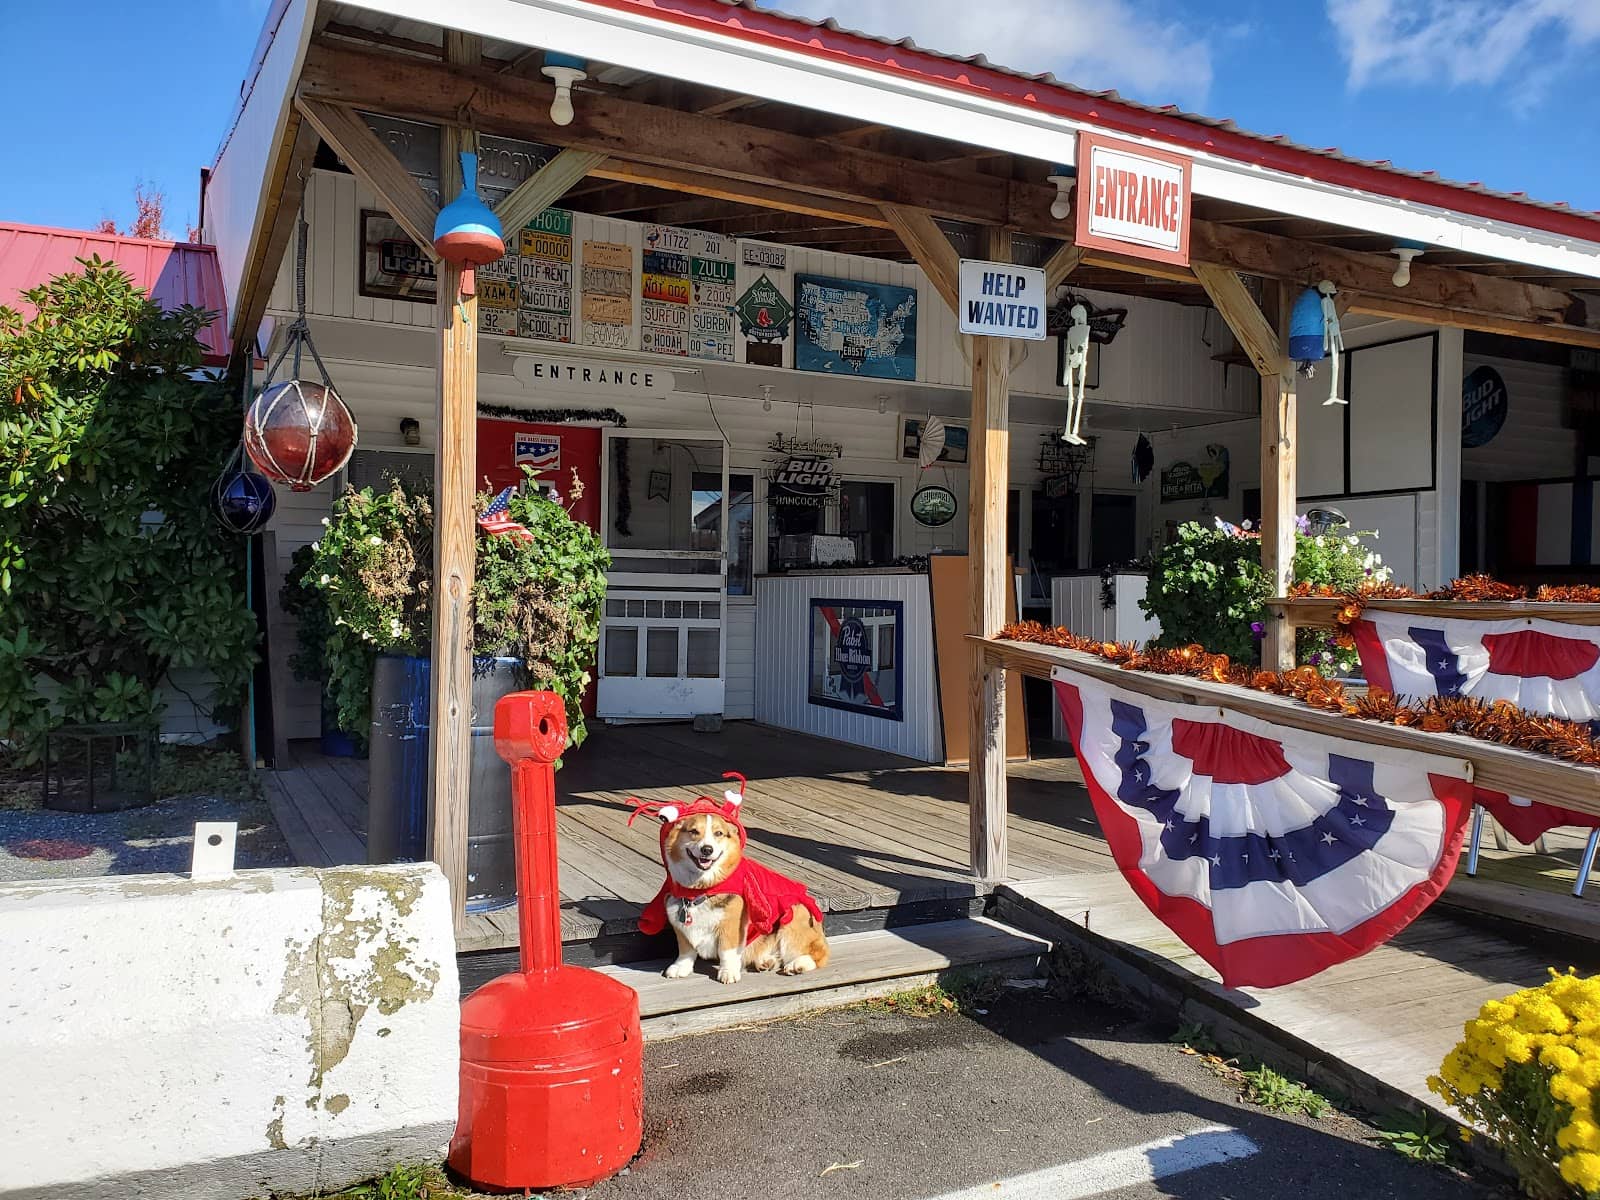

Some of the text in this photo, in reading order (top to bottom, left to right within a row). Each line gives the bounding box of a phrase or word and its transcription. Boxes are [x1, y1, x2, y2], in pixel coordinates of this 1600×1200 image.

[1095, 165, 1178, 232] ENTRANCE
[663, 234, 689, 249] 11722
[698, 260, 728, 278] ZULU
[982, 272, 1026, 298] HELP
[527, 291, 570, 309] UGOTTAB
[485, 314, 498, 327] 92
[644, 308, 686, 325] SURFUR
[693, 314, 731, 332] SUBRBN
[968, 300, 1039, 329] WANTED
[529, 319, 569, 336] COOL-IT
[654, 333, 682, 349] HOOAH
[534, 363, 653, 387] ENTRANCE
[1463, 379, 1494, 411] BUD
[1465, 388, 1503, 426] IGHT
[786, 460, 833, 474] BUD
[777, 472, 841, 487] LIGHT
[842, 625, 862, 647] Pabst
[848, 648, 871, 664] Ribbon
